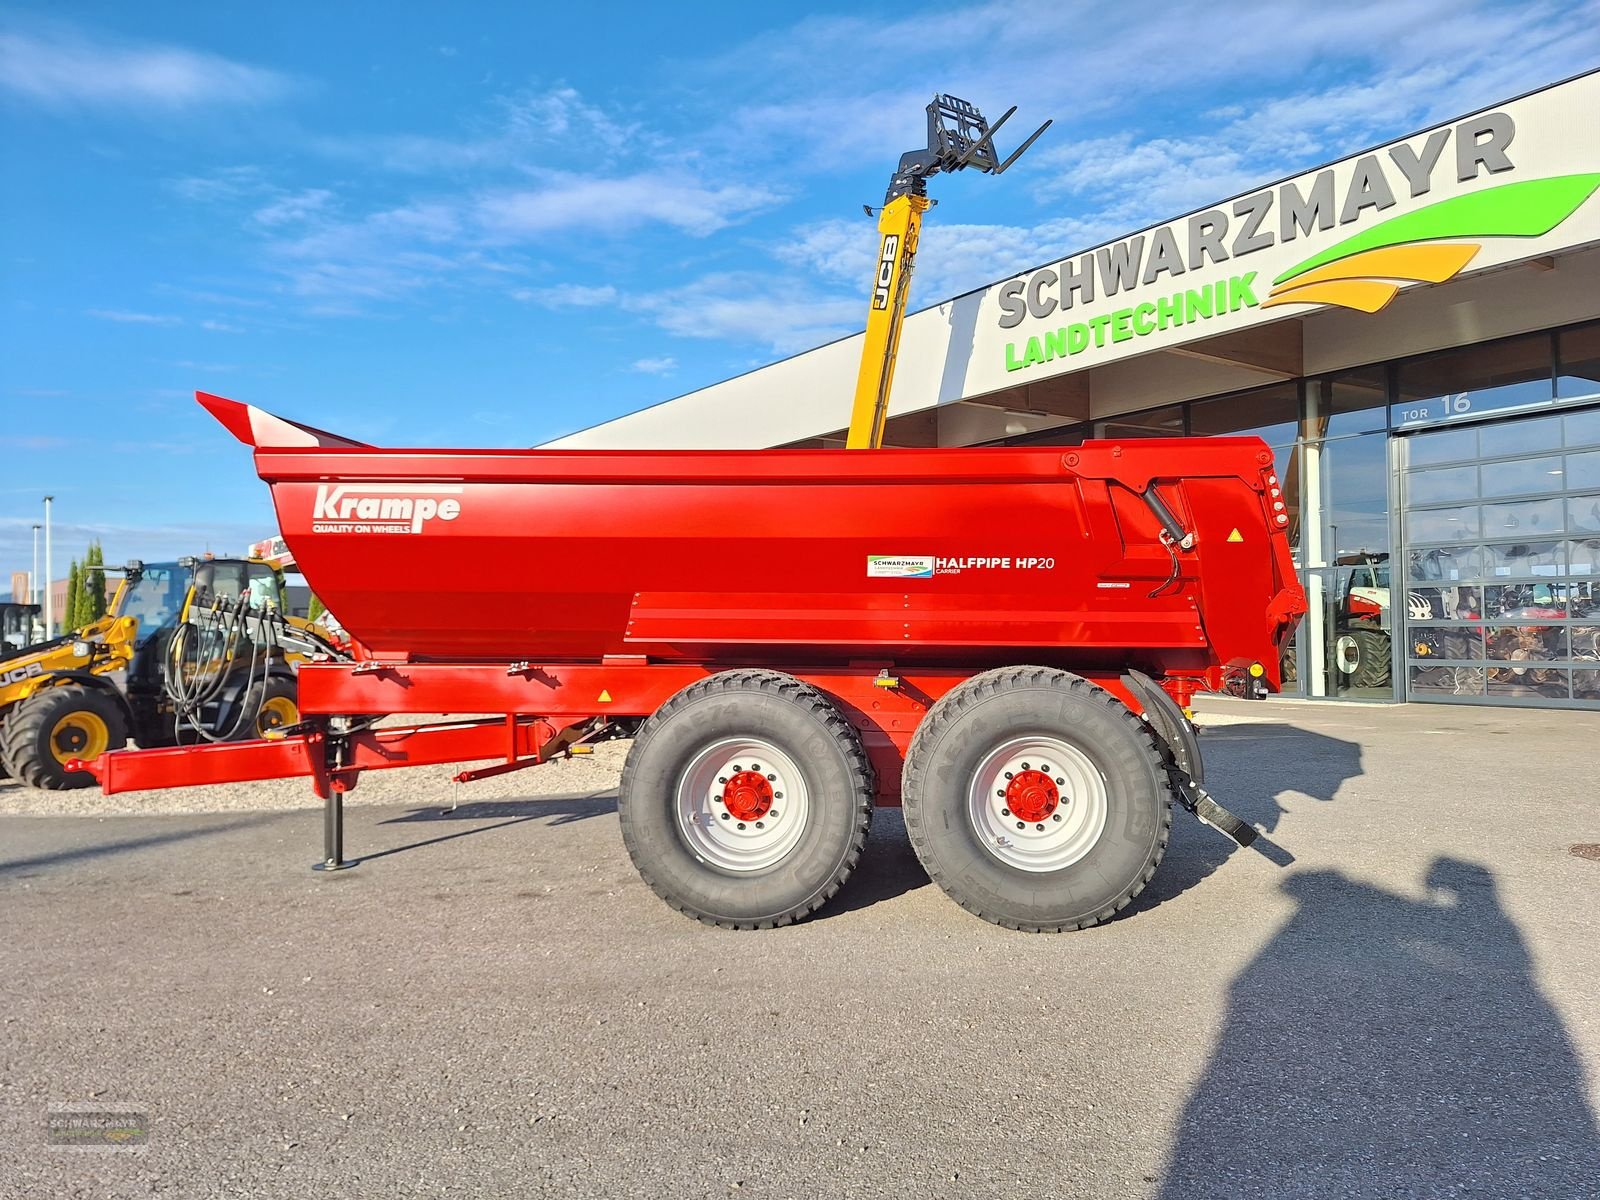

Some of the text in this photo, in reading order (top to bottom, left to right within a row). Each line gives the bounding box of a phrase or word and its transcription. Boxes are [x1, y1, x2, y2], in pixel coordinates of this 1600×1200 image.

[998, 112, 1516, 328] SCHWARZMAYR
[874, 235, 897, 309] JCB
[1005, 271, 1259, 372] LANDTECHNIK
[1401, 392, 1471, 421] TOR 16
[313, 484, 463, 534] Krampe
[313, 525, 410, 533] QUALITY ON WHEELS
[936, 557, 1055, 569] HALFPIPE HP20
[0, 662, 43, 687] JCB
